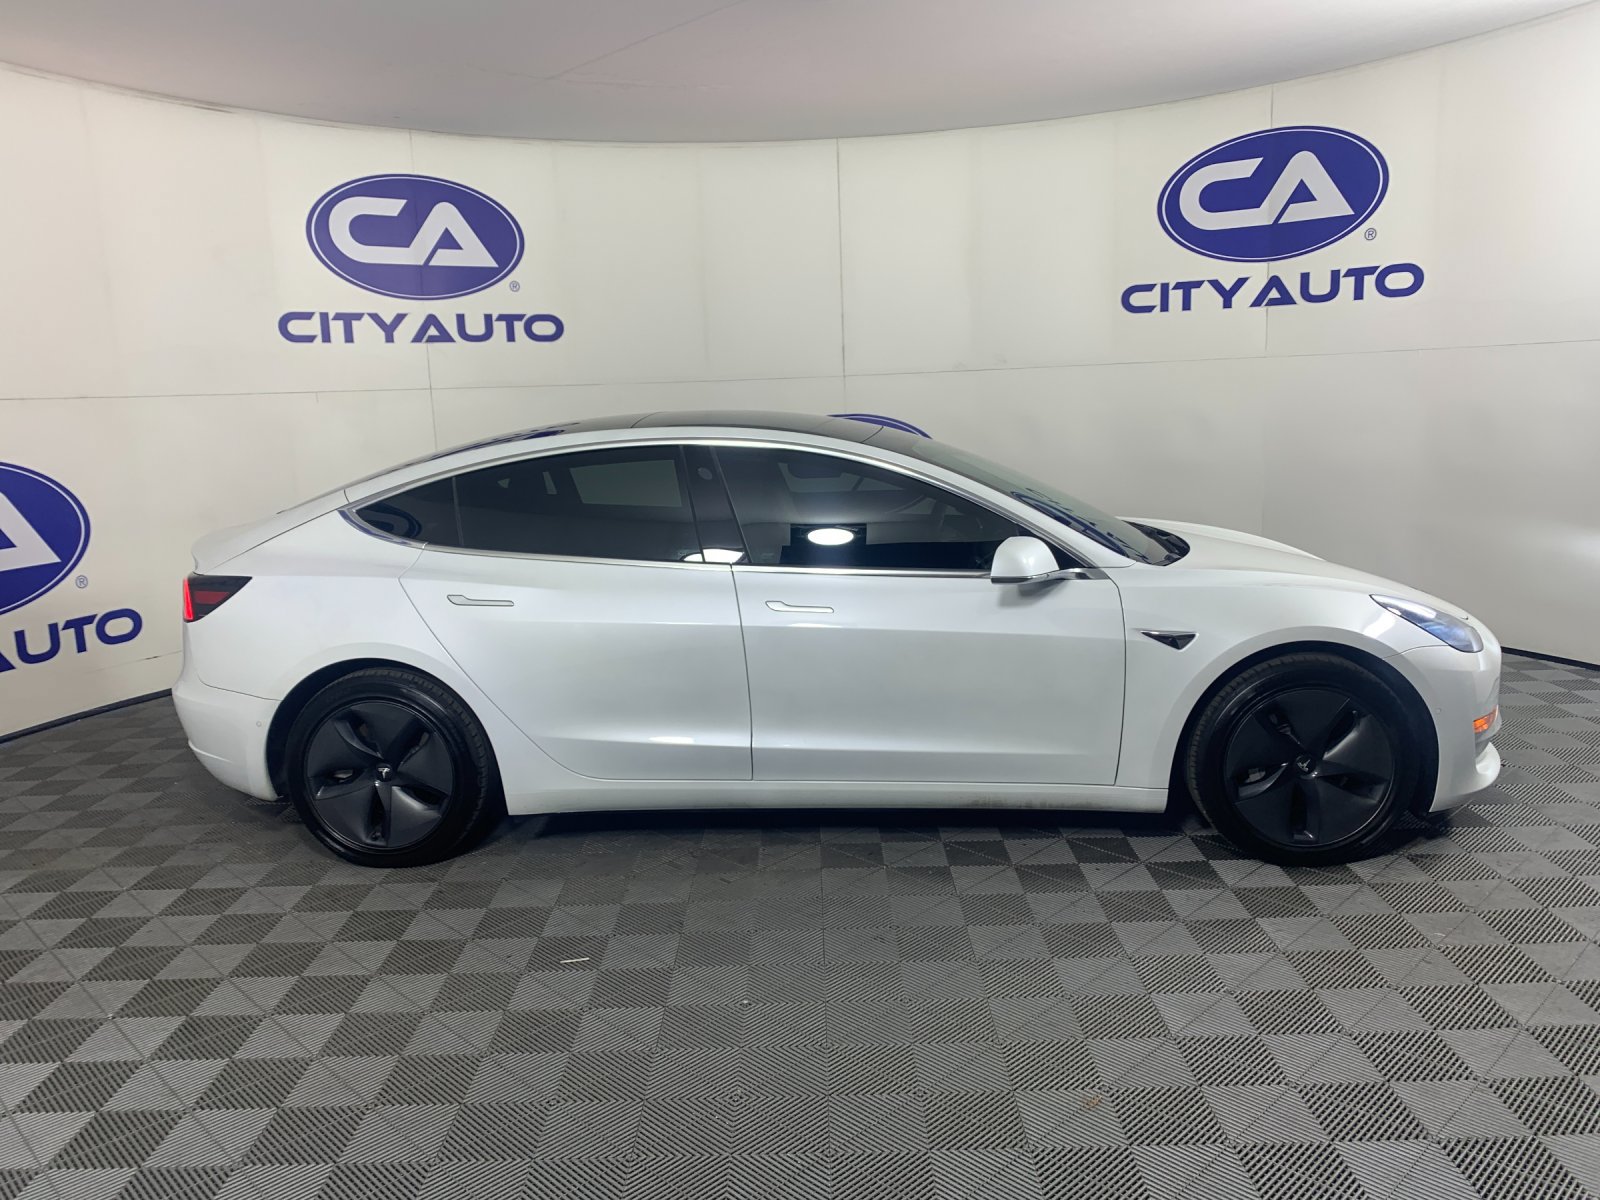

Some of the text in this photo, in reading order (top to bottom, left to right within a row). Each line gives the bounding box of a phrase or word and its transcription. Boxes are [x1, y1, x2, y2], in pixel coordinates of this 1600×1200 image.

[1179, 150, 1355, 231] CA
[328, 196, 499, 268] CA
[1121, 263, 1425, 313] CITY AUTO
[278, 311, 564, 343] CITY AUTO
